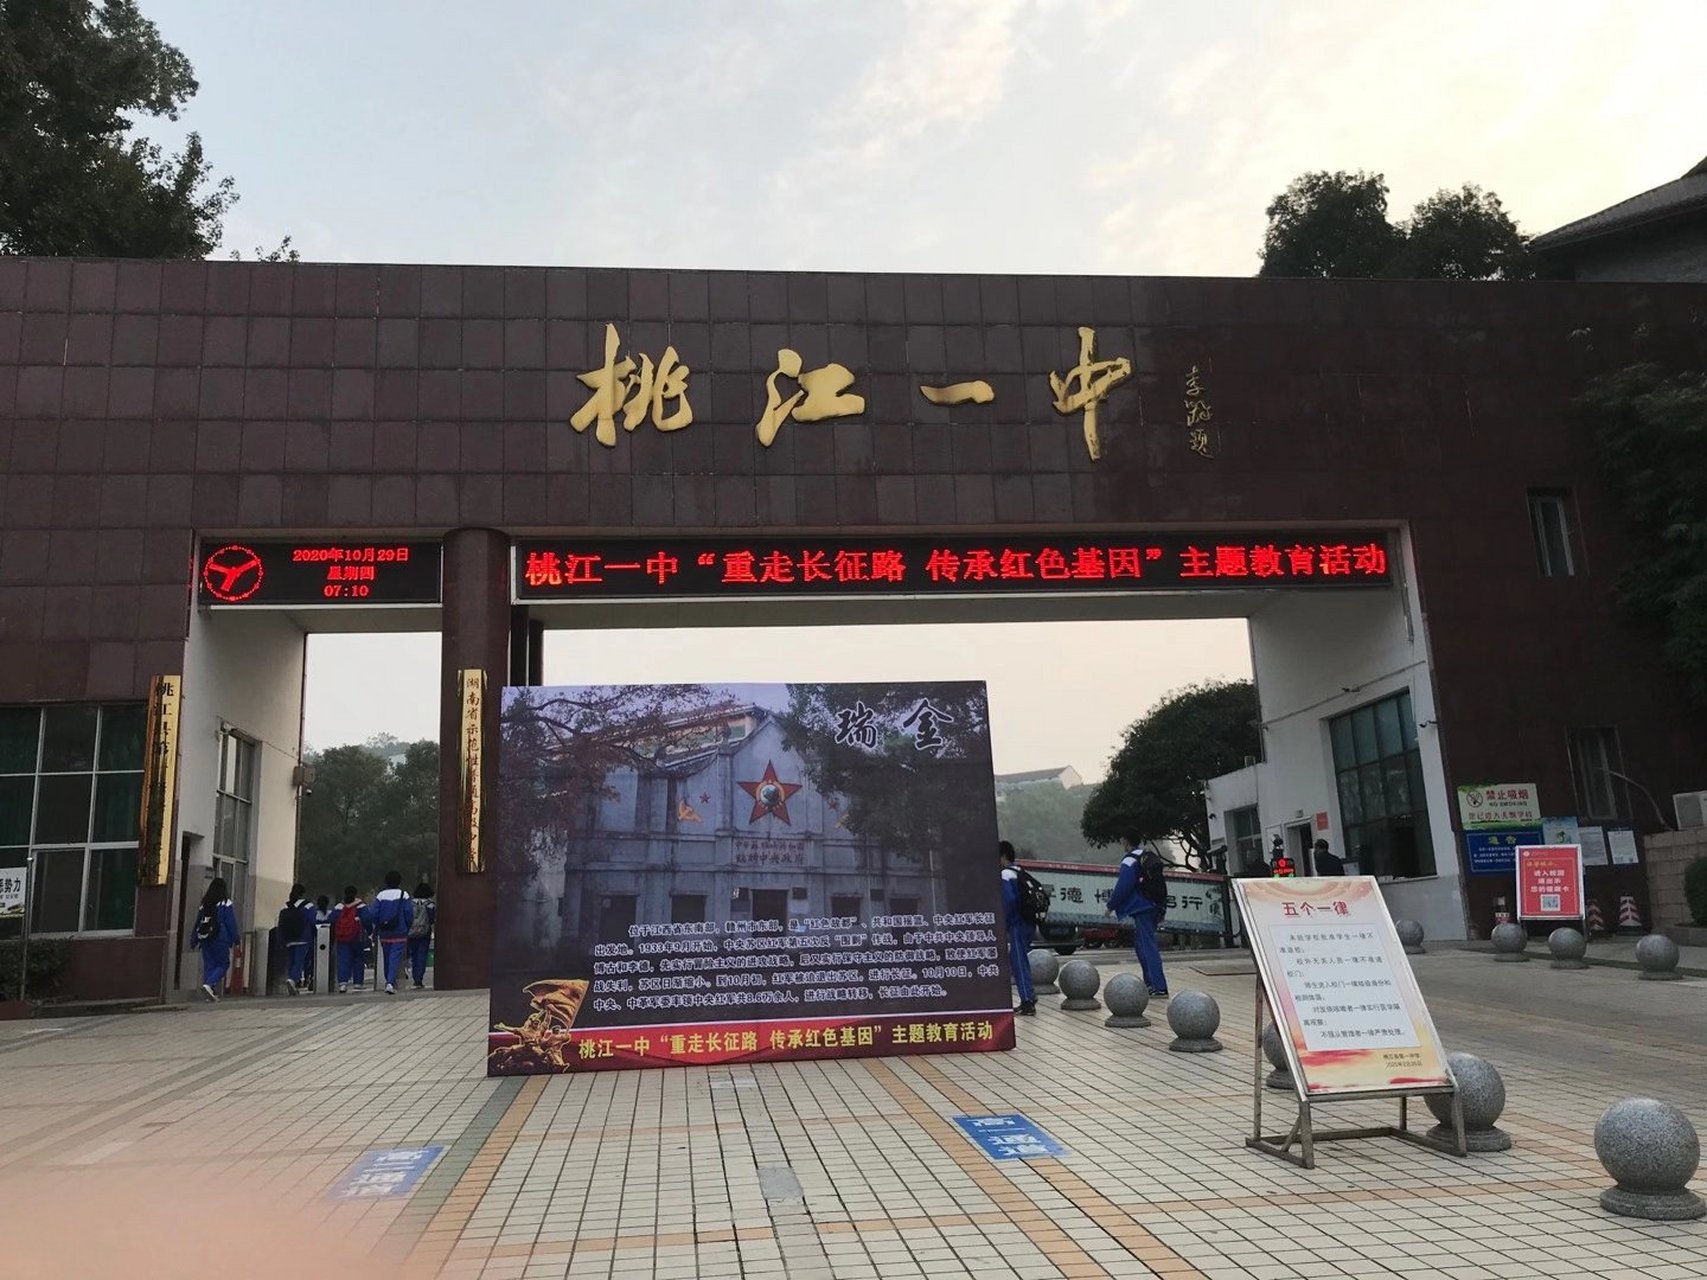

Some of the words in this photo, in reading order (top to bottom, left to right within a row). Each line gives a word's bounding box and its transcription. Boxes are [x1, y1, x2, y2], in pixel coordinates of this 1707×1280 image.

[569, 322, 1132, 462] 桃江一中
[292, 547, 409, 562] 2020年10月29日
[327, 565, 376, 581] 星期四
[323, 584, 370, 598] 07:10
[834, 697, 954, 750] 瑞金
[1486, 789, 1529, 800] 禁止吸烟
[1282, 901, 1349, 916] 五个一律
